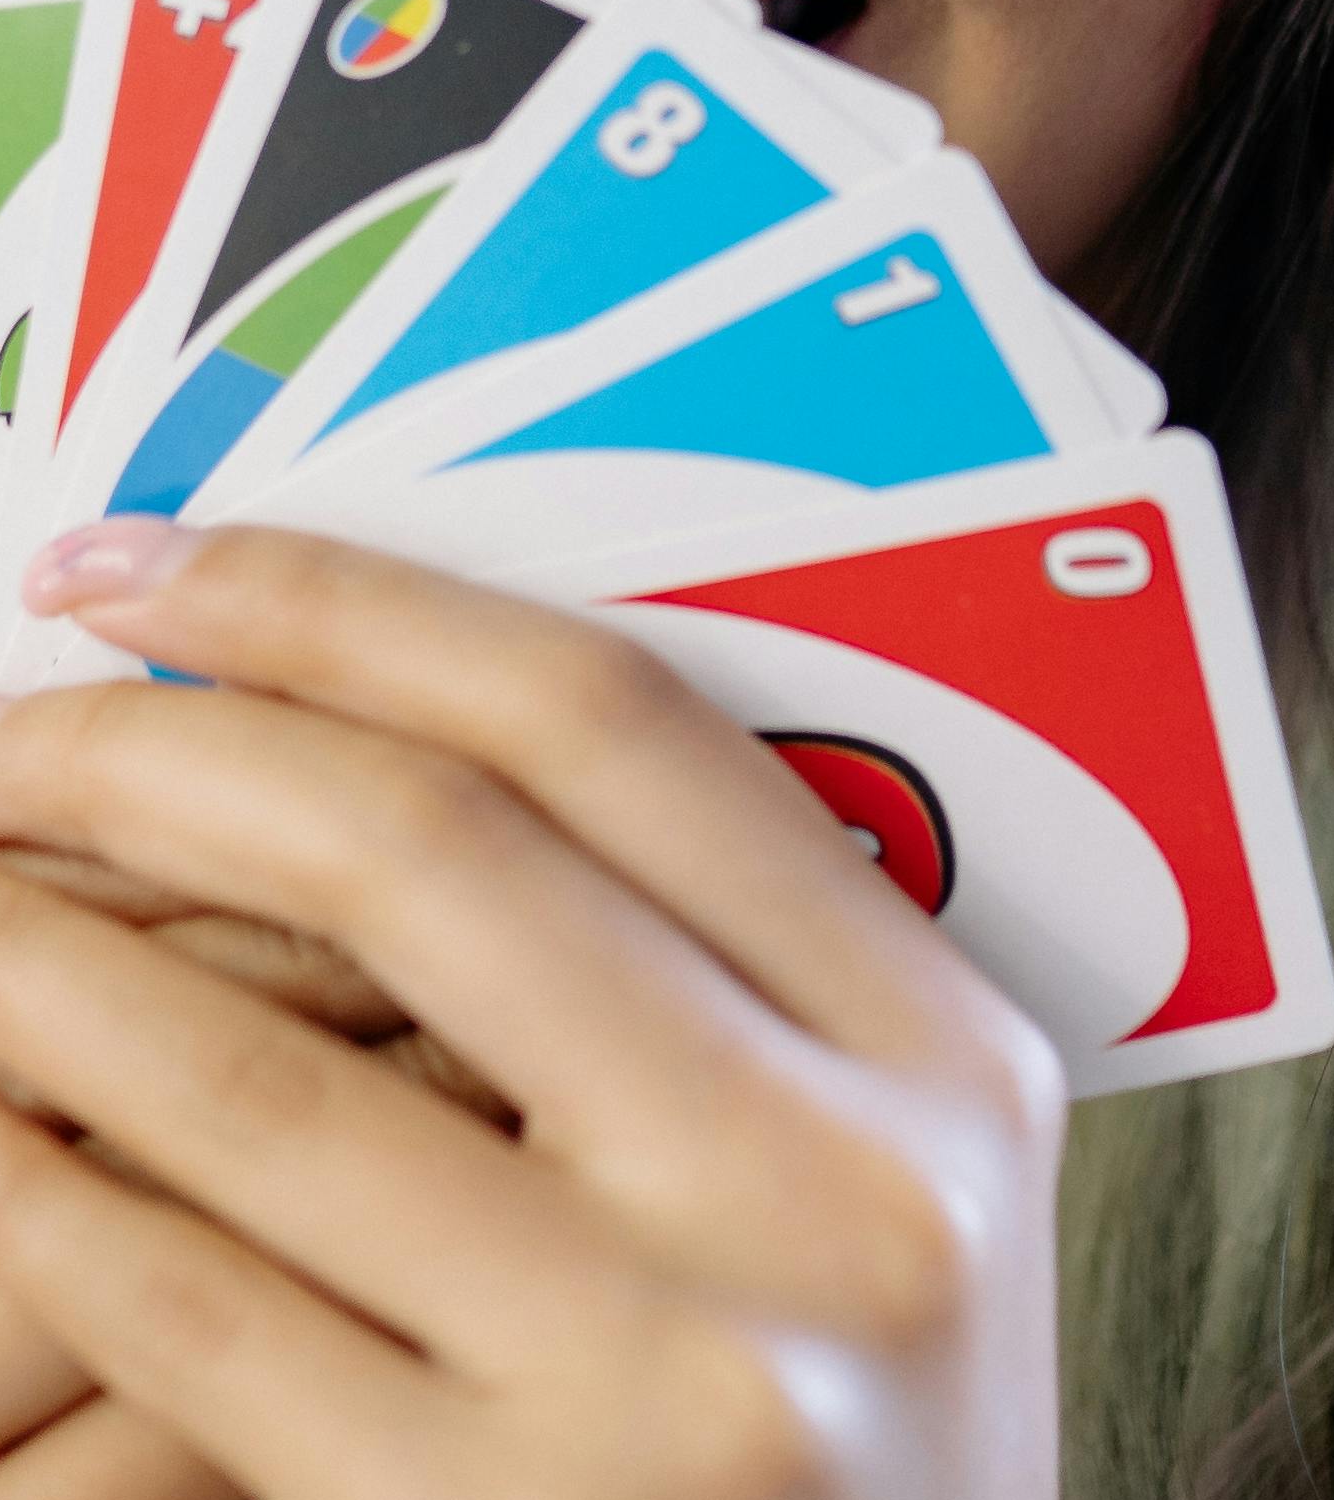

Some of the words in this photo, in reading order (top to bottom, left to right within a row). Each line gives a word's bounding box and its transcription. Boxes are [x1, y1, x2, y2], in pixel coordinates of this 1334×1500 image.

[596, 80, 707, 178] 8
[835, 257, 943, 327] 1
[1043, 526, 1153, 598] 0
